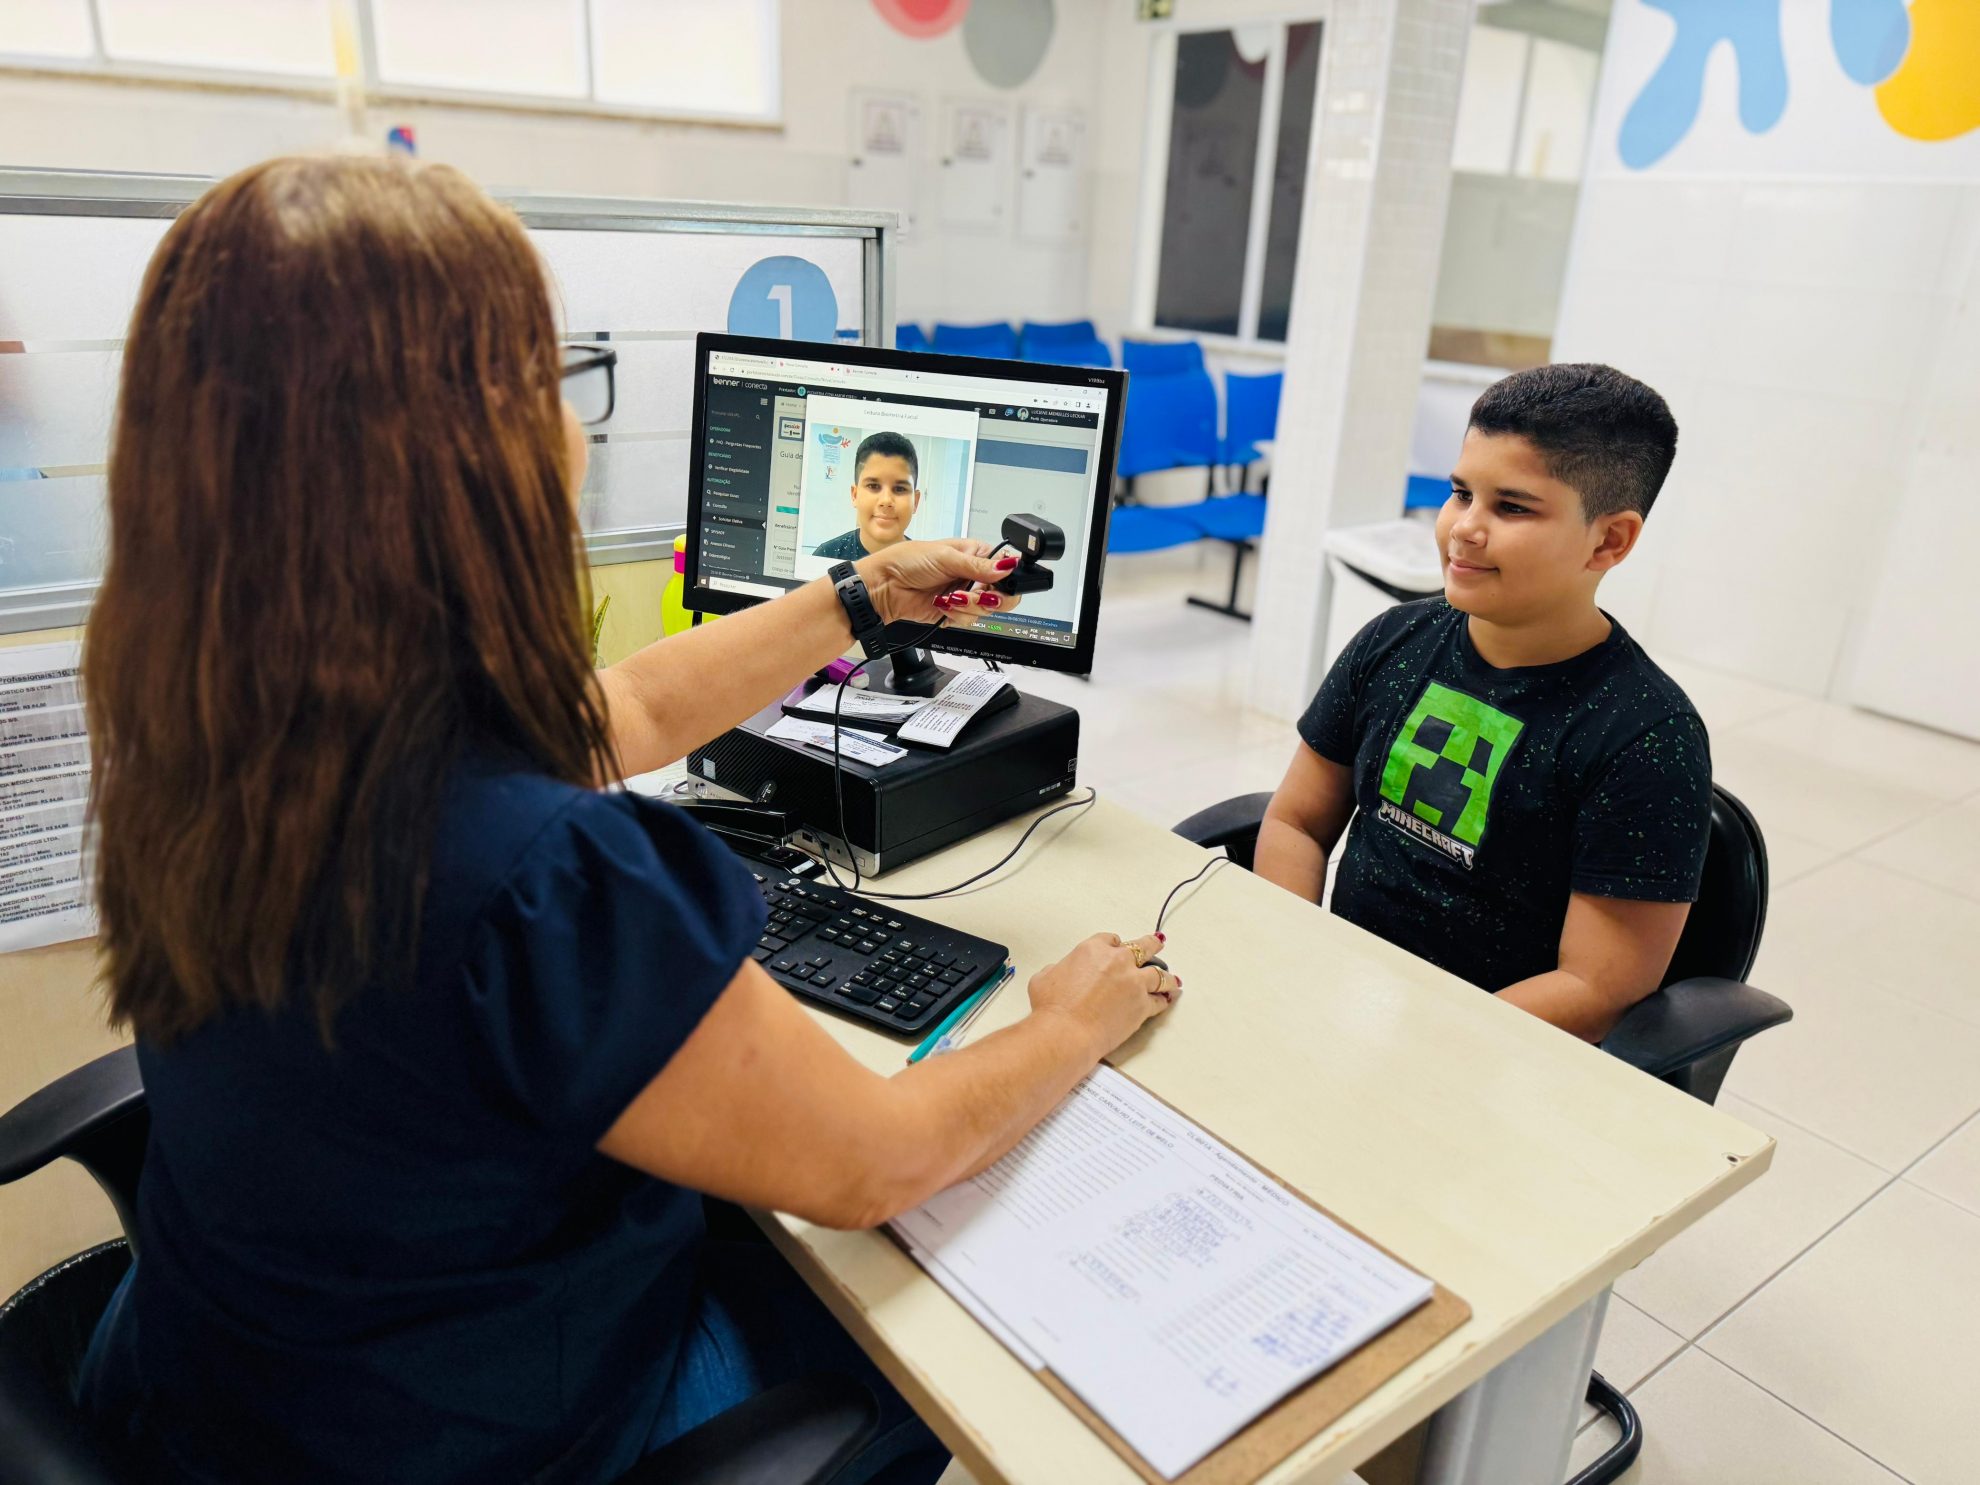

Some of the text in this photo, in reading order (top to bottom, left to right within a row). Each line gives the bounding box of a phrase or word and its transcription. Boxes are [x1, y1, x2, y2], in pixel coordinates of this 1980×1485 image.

[767, 285, 793, 341] 1
[713, 376, 740, 387] benner
[744, 382, 768, 391] conecta
[780, 450, 794, 459] Guia
[1380, 800, 1474, 868] MINECRAFT
